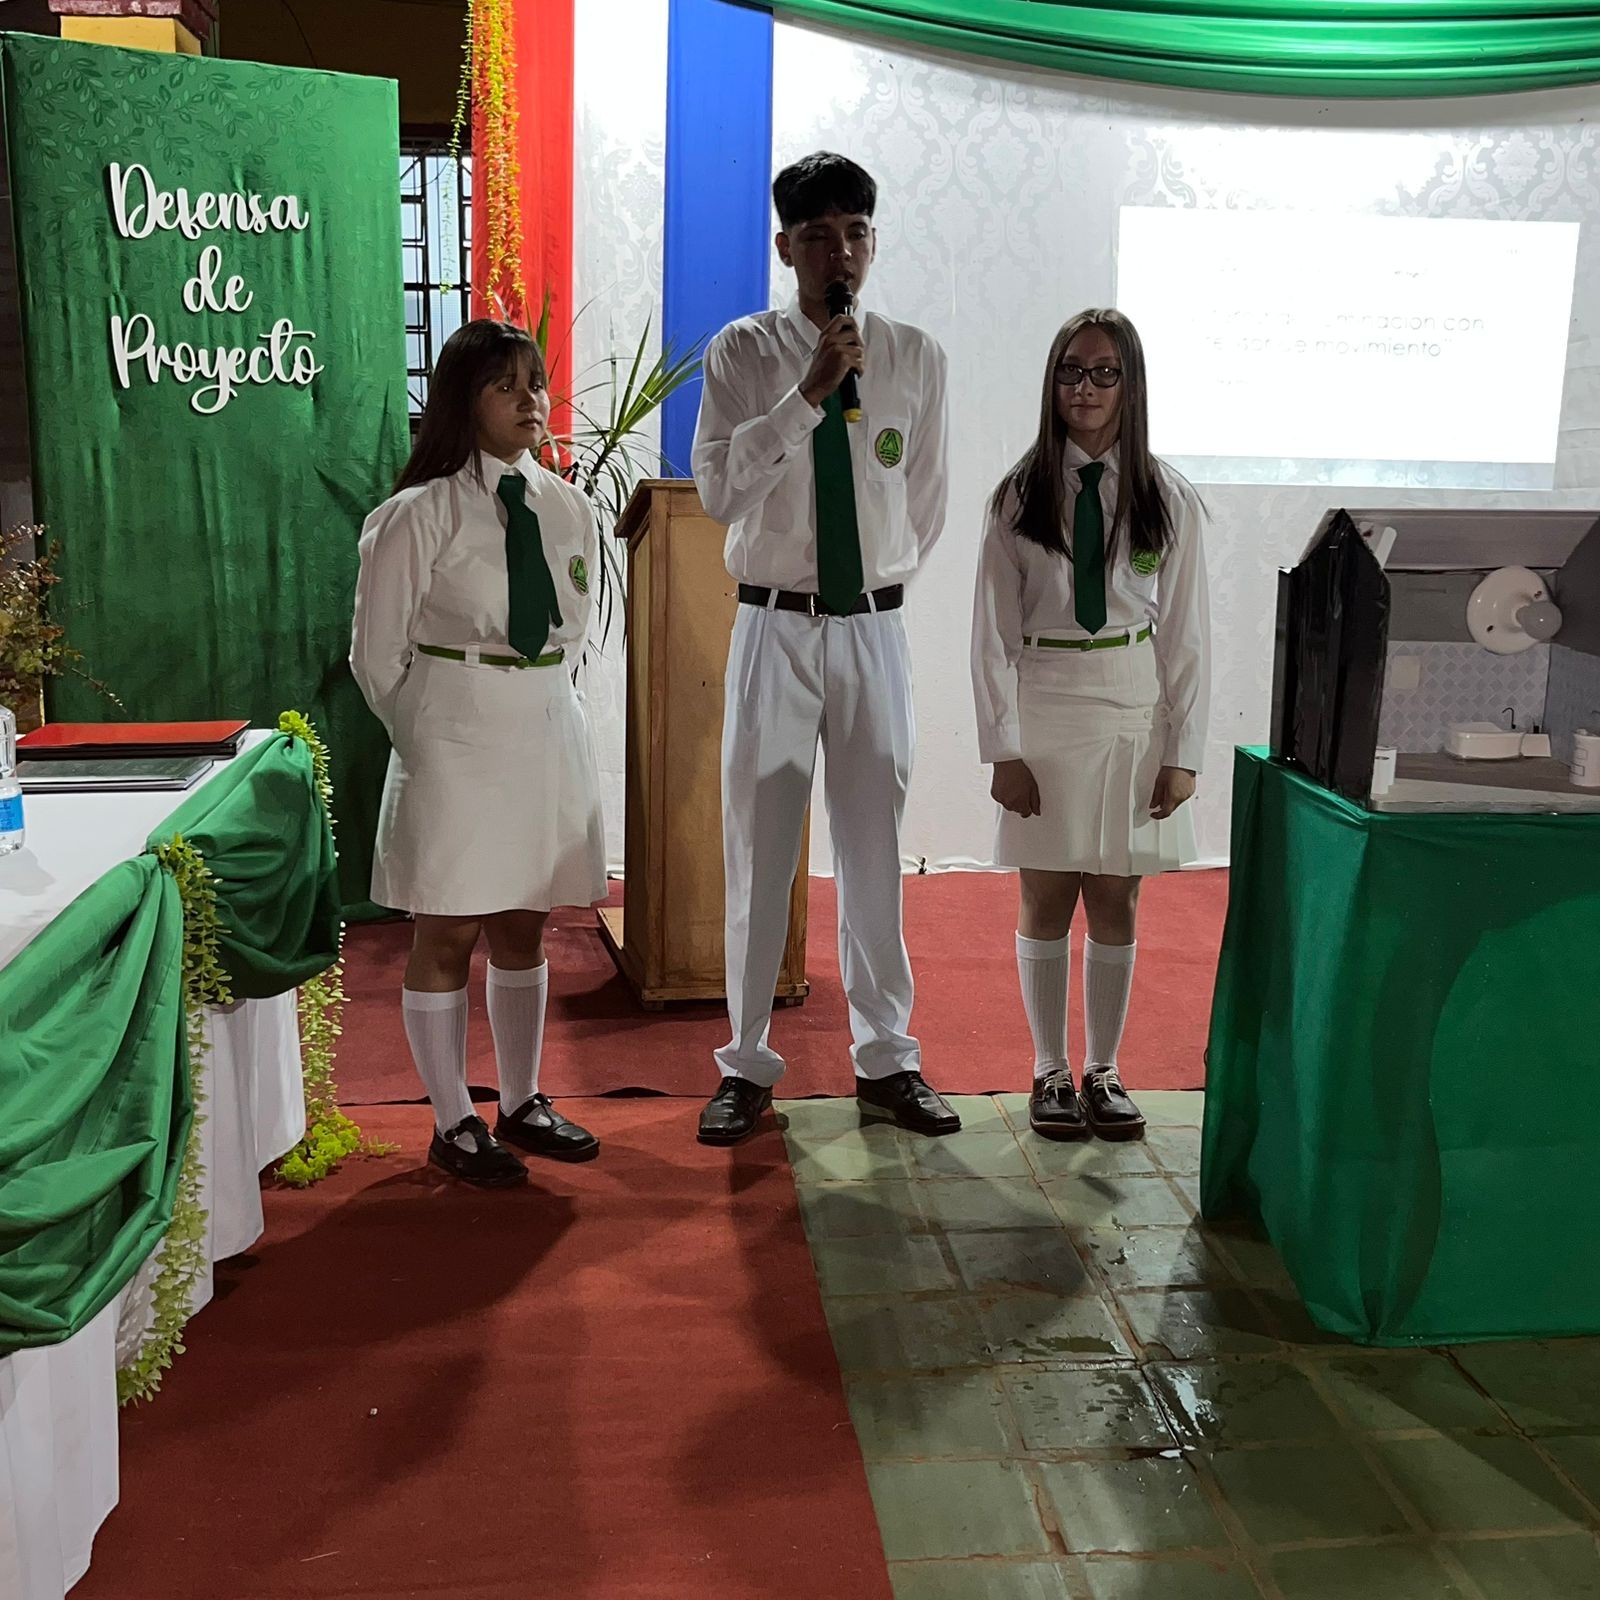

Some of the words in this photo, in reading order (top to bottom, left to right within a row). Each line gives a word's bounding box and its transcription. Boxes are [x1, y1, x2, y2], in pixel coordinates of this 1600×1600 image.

[108, 162, 310, 240] Defensa
[183, 245, 254, 313] de
[1443, 316, 1485, 332] con
[110, 313, 325, 414] Proyecto
